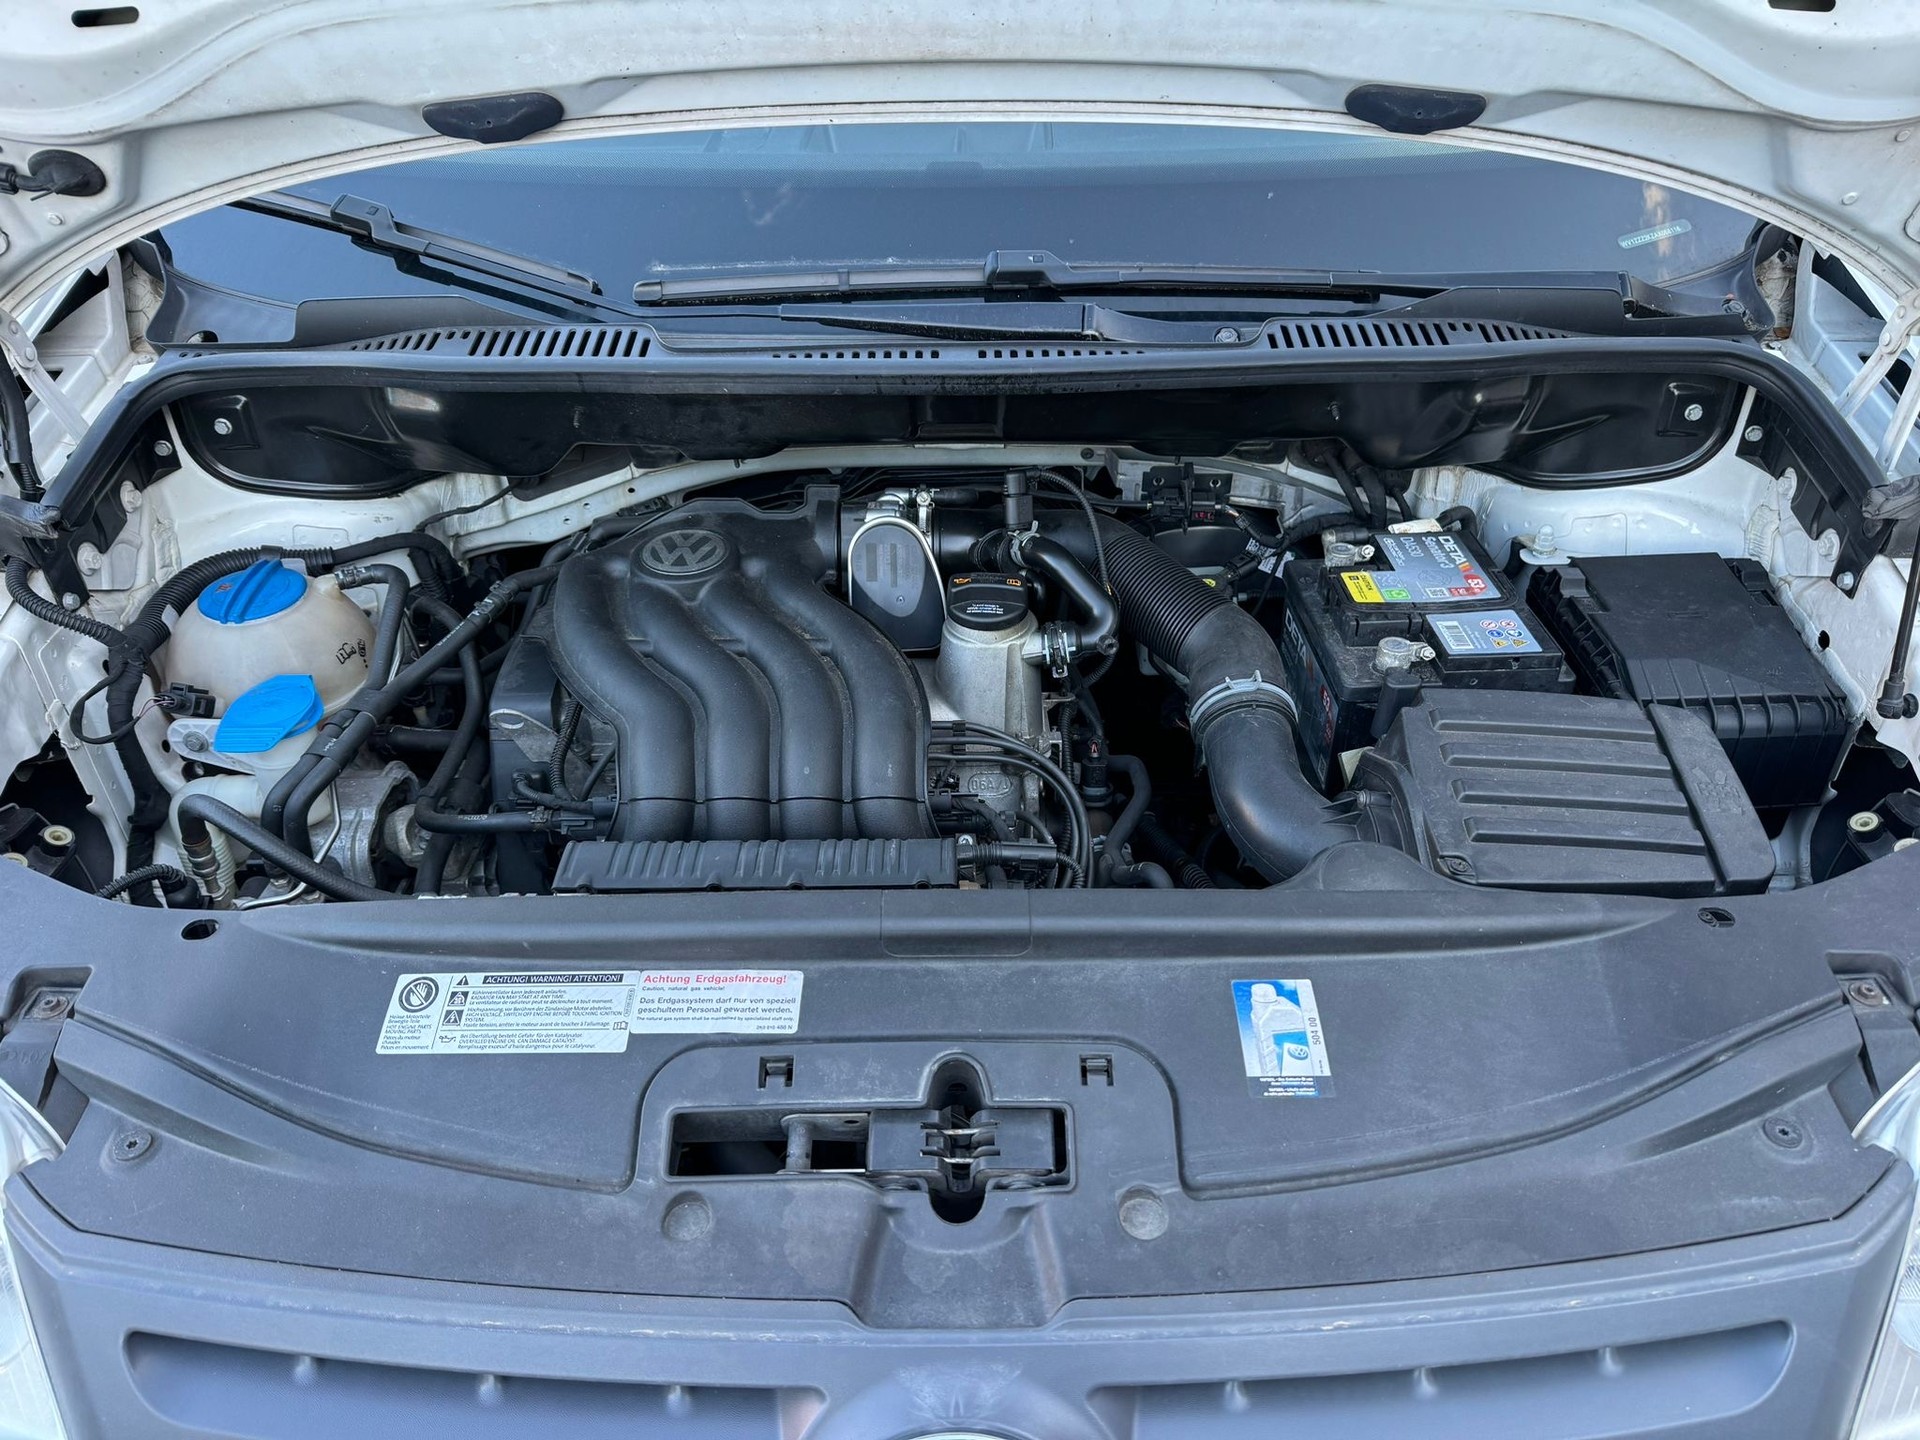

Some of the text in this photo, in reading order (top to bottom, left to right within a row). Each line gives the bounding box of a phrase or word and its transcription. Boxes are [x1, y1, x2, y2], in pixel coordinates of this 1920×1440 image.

[643, 530, 725, 573] VW
[1438, 535, 1467, 565] DETA
[1285, 607, 1307, 668] DETA
[486, 975, 621, 984] ACHTUNG! WARNING! ATTENTION!
[644, 974, 787, 984] Achtung Erdgasfahrzeug!
[1308, 1017, 1321, 1045] 504 00
